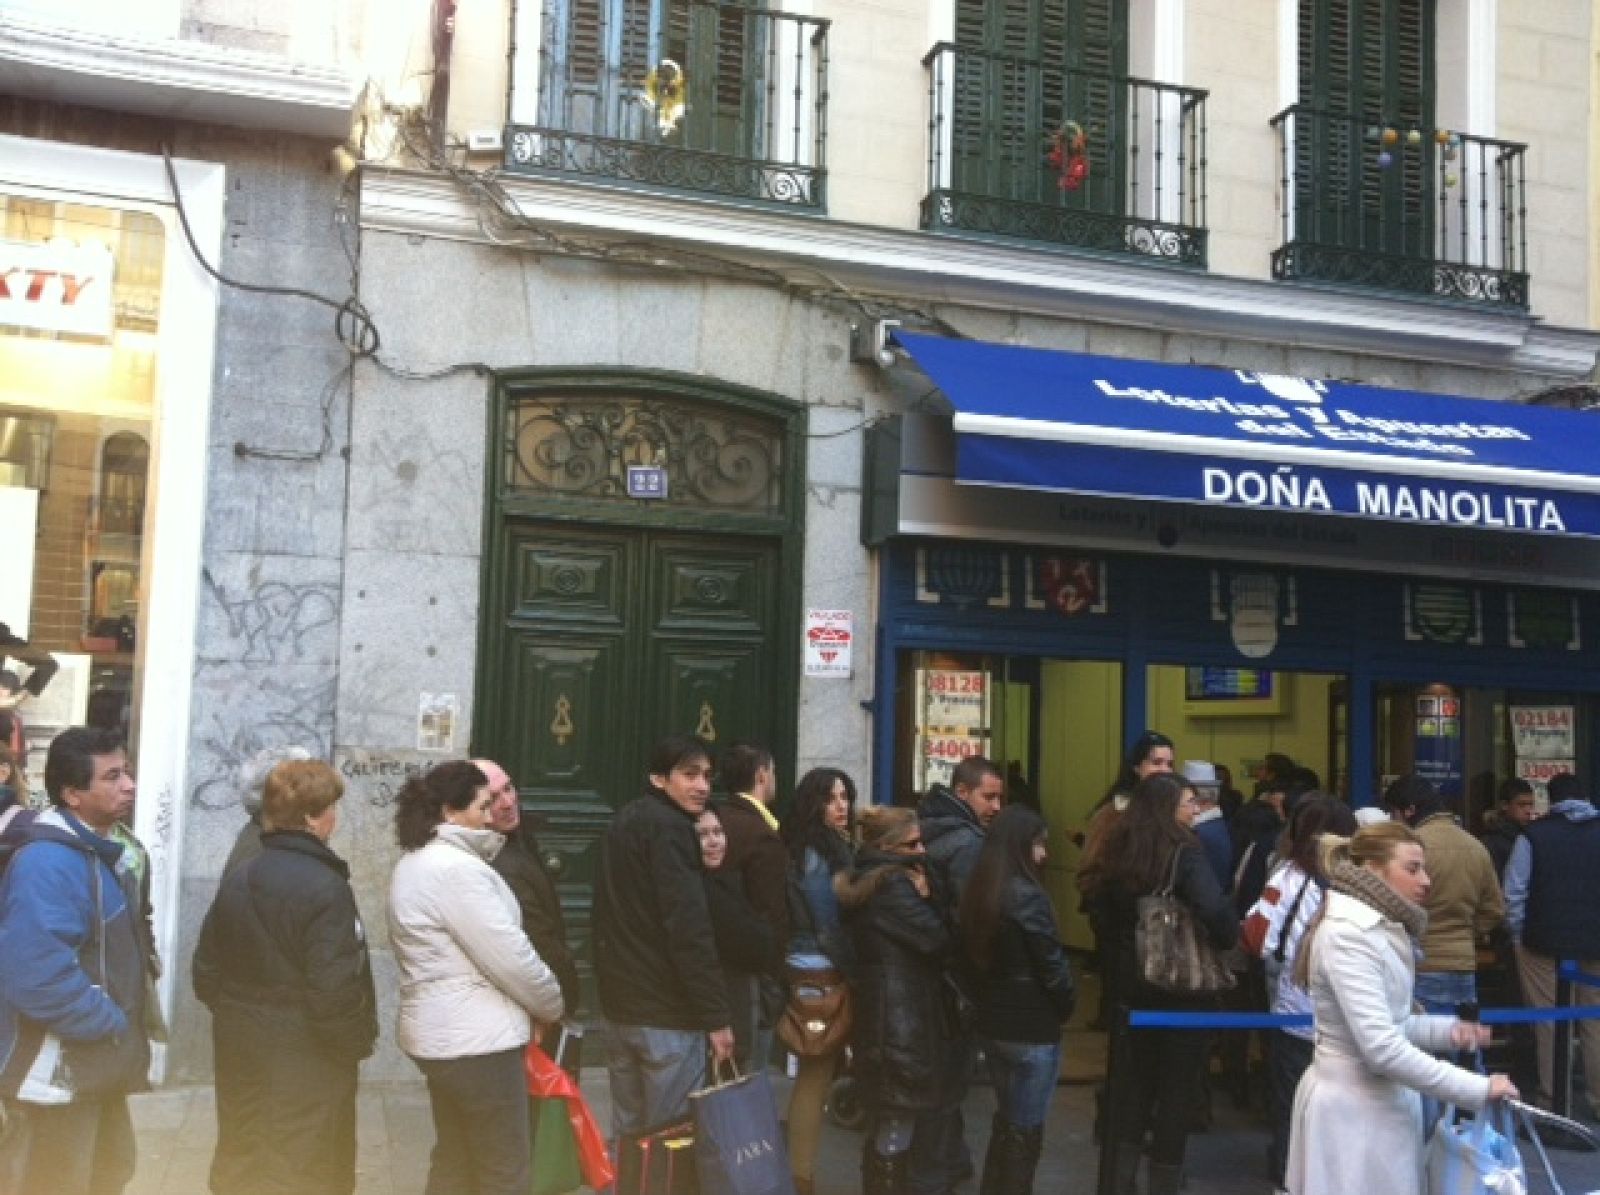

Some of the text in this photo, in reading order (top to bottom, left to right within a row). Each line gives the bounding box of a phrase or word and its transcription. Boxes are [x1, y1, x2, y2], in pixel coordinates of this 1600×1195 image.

[1203, 466, 1567, 533] DOÑA MANOLITA
[735, 1138, 774, 1167] ZARA
